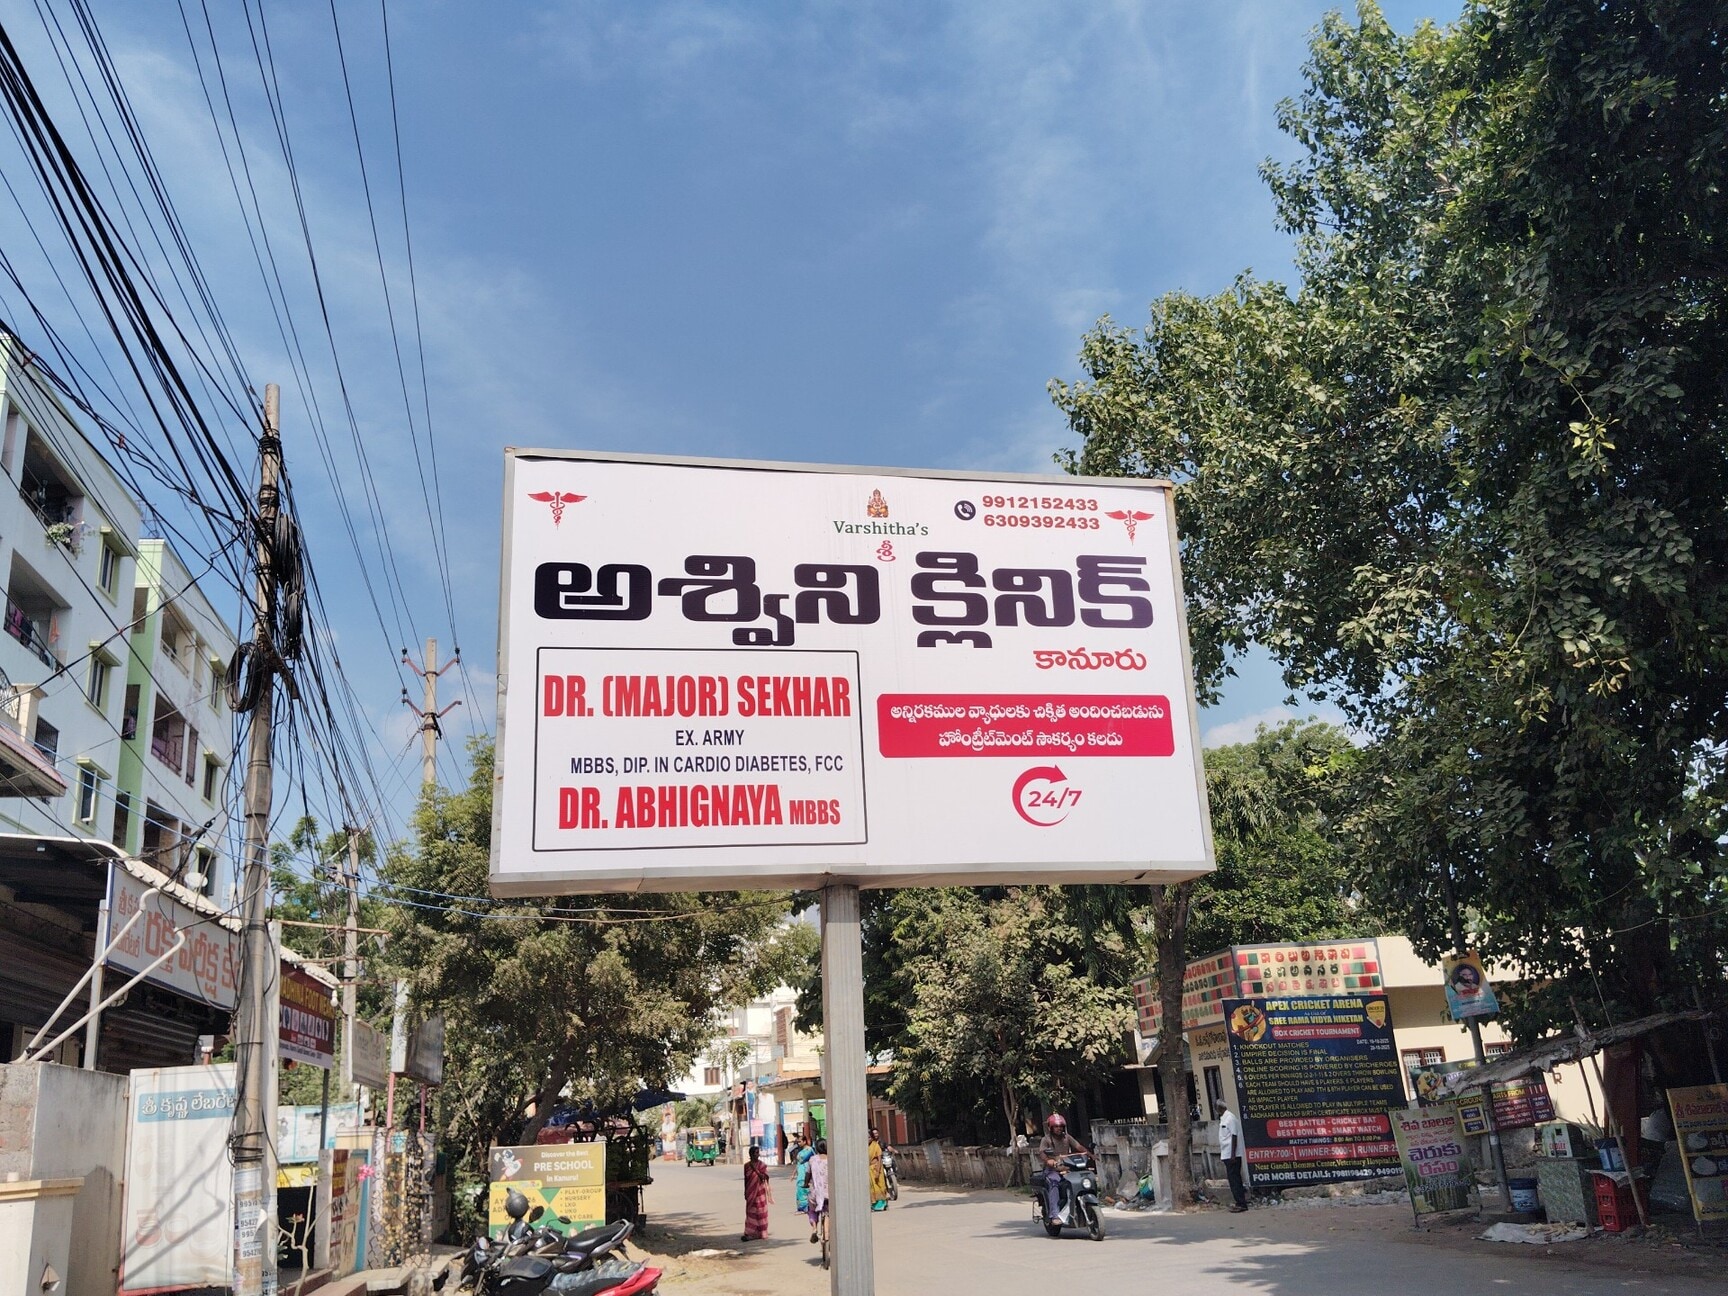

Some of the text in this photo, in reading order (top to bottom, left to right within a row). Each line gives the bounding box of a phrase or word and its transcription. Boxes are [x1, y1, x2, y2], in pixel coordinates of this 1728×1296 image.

[982, 495, 1098, 512] 9912152433
[833, 520, 929, 536] Varshitha's
[984, 514, 1100, 530] 6309392433
[876, 540, 896, 562] శ్రీ
[534, 551, 1154, 649] అశ్విని క్లినిక్
[1033, 647, 1147, 672] కానూరు
[543, 675, 594, 718] DR.
[736, 676, 852, 718] SEKHAR
[890, 704, 966, 723] అన్నిరకముల
[1068, 704, 1164, 720] అందించబడును
[675, 730, 745, 746] EX. ARMY
[1087, 731, 1124, 747] కలదు
[570, 754, 844, 776] MBBS, DIP. IN CARDIO DIABETES, FCC
[1028, 787, 1082, 809] 24/7
[558, 784, 841, 830] DR. ABHIGNAYA MBBS
[1266, 998, 1364, 1010] APEX CRICKET ARENA
[1268, 1014, 1364, 1025] SREE RAMA VIDYA NIKETAN
[1274, 1027, 1360, 1037] BOX CRICKET TOURNAMENT
[1508, 1089, 1525, 1097] FROM
[1299, 1118, 1326, 1127] BATTER
[1299, 1128, 1327, 1136] BOWLER
[534, 1160, 593, 1172] PRE SCHOOL
[1253, 1173, 1270, 1182] FOR
[1272, 1172, 1295, 1181] MORE
[1297, 1170, 1331, 1180] DETAILS:
